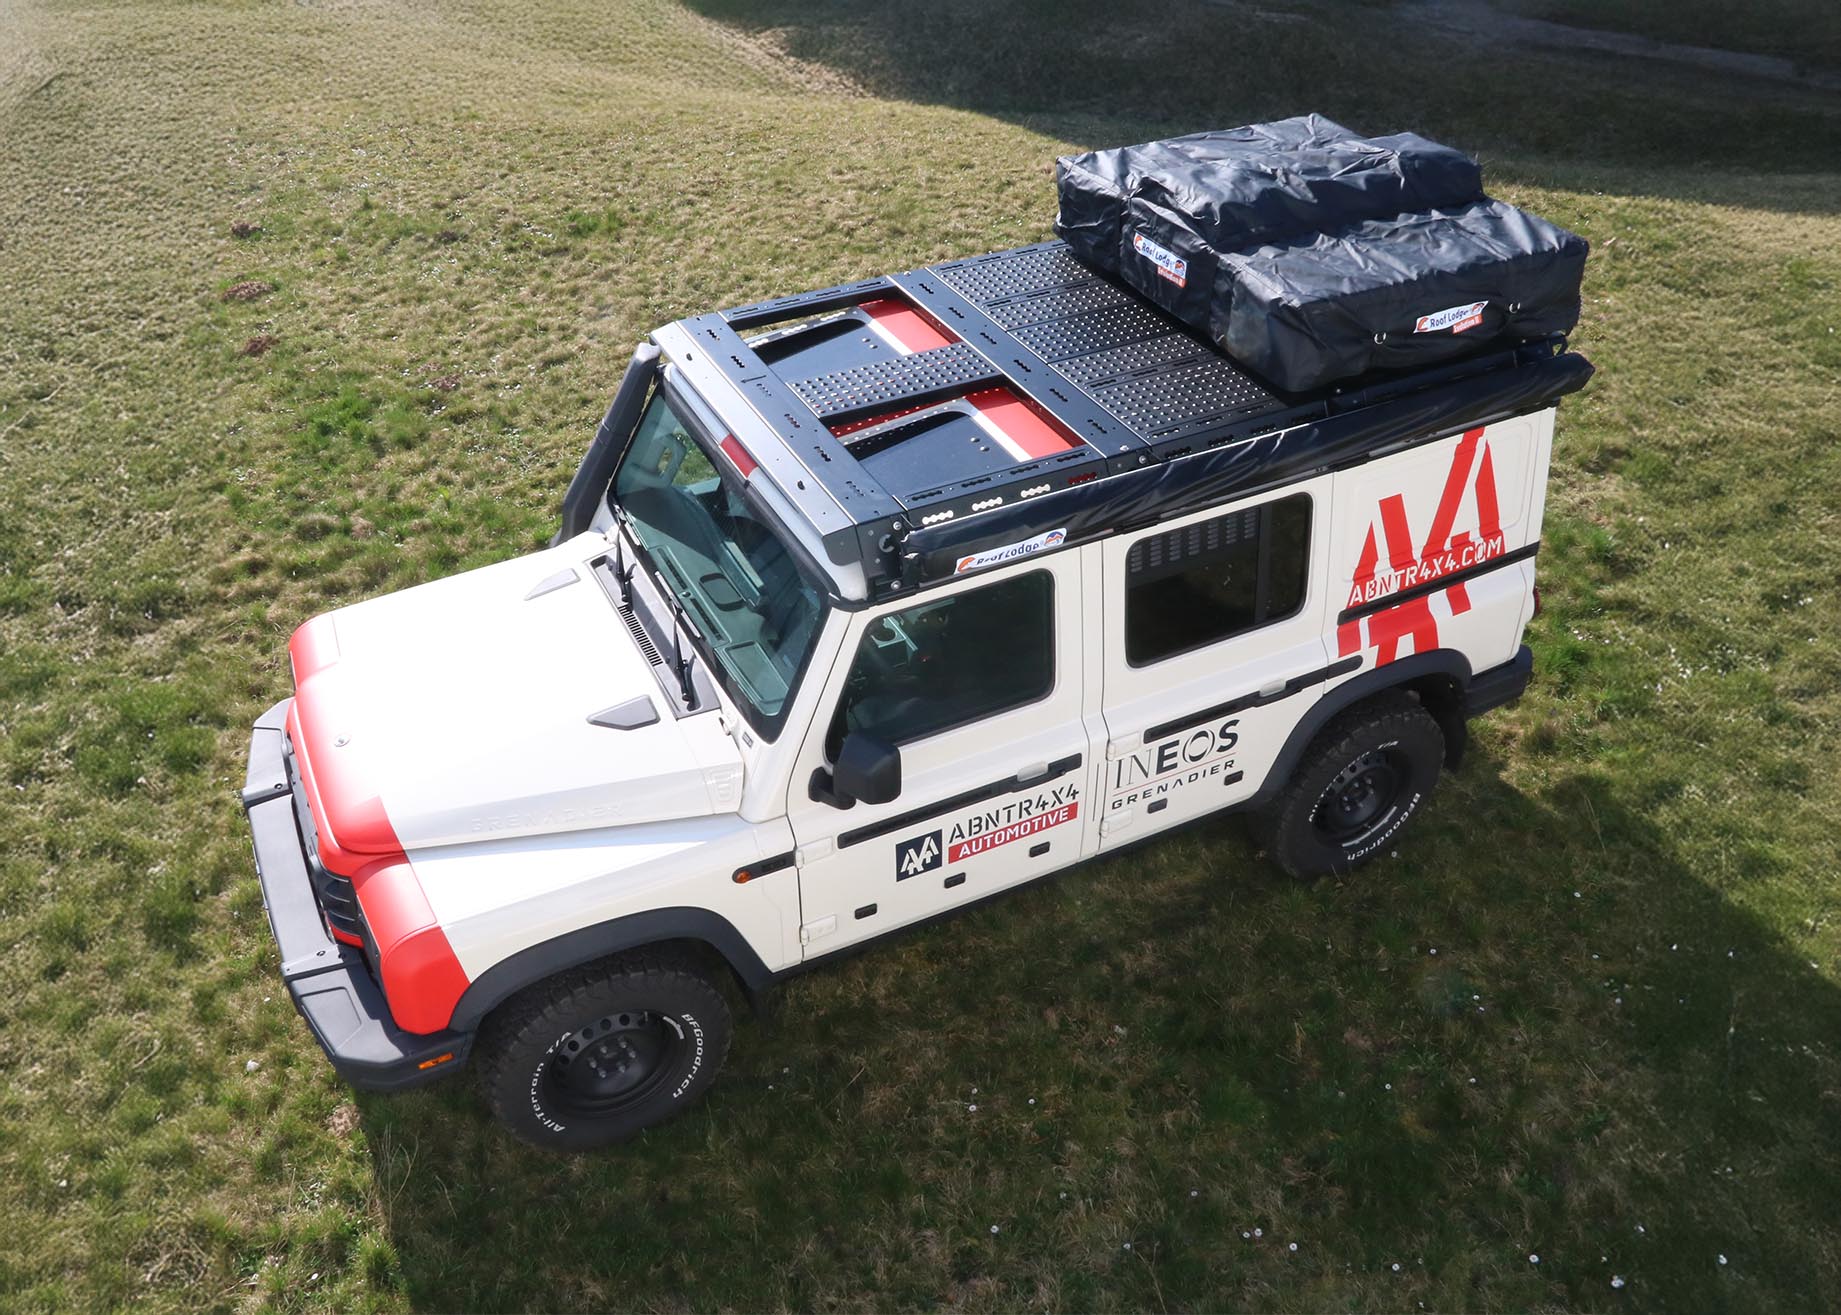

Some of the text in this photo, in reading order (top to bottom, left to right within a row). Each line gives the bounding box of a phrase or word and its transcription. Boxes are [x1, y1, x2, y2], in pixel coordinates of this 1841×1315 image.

[1430, 310, 1469, 328] Roof Lodge
[1349, 535, 1503, 607] ABNTR4X4.COM
[1111, 759, 1236, 811] GRENADIER
[1114, 719, 1241, 790] INEOS
[948, 783, 1080, 844] ABNTR4X4
[958, 807, 1070, 858] AUTOMOTIVE
[671, 1012, 704, 1099] BFGoodrich
[530, 1062, 566, 1133] All-Terrain
